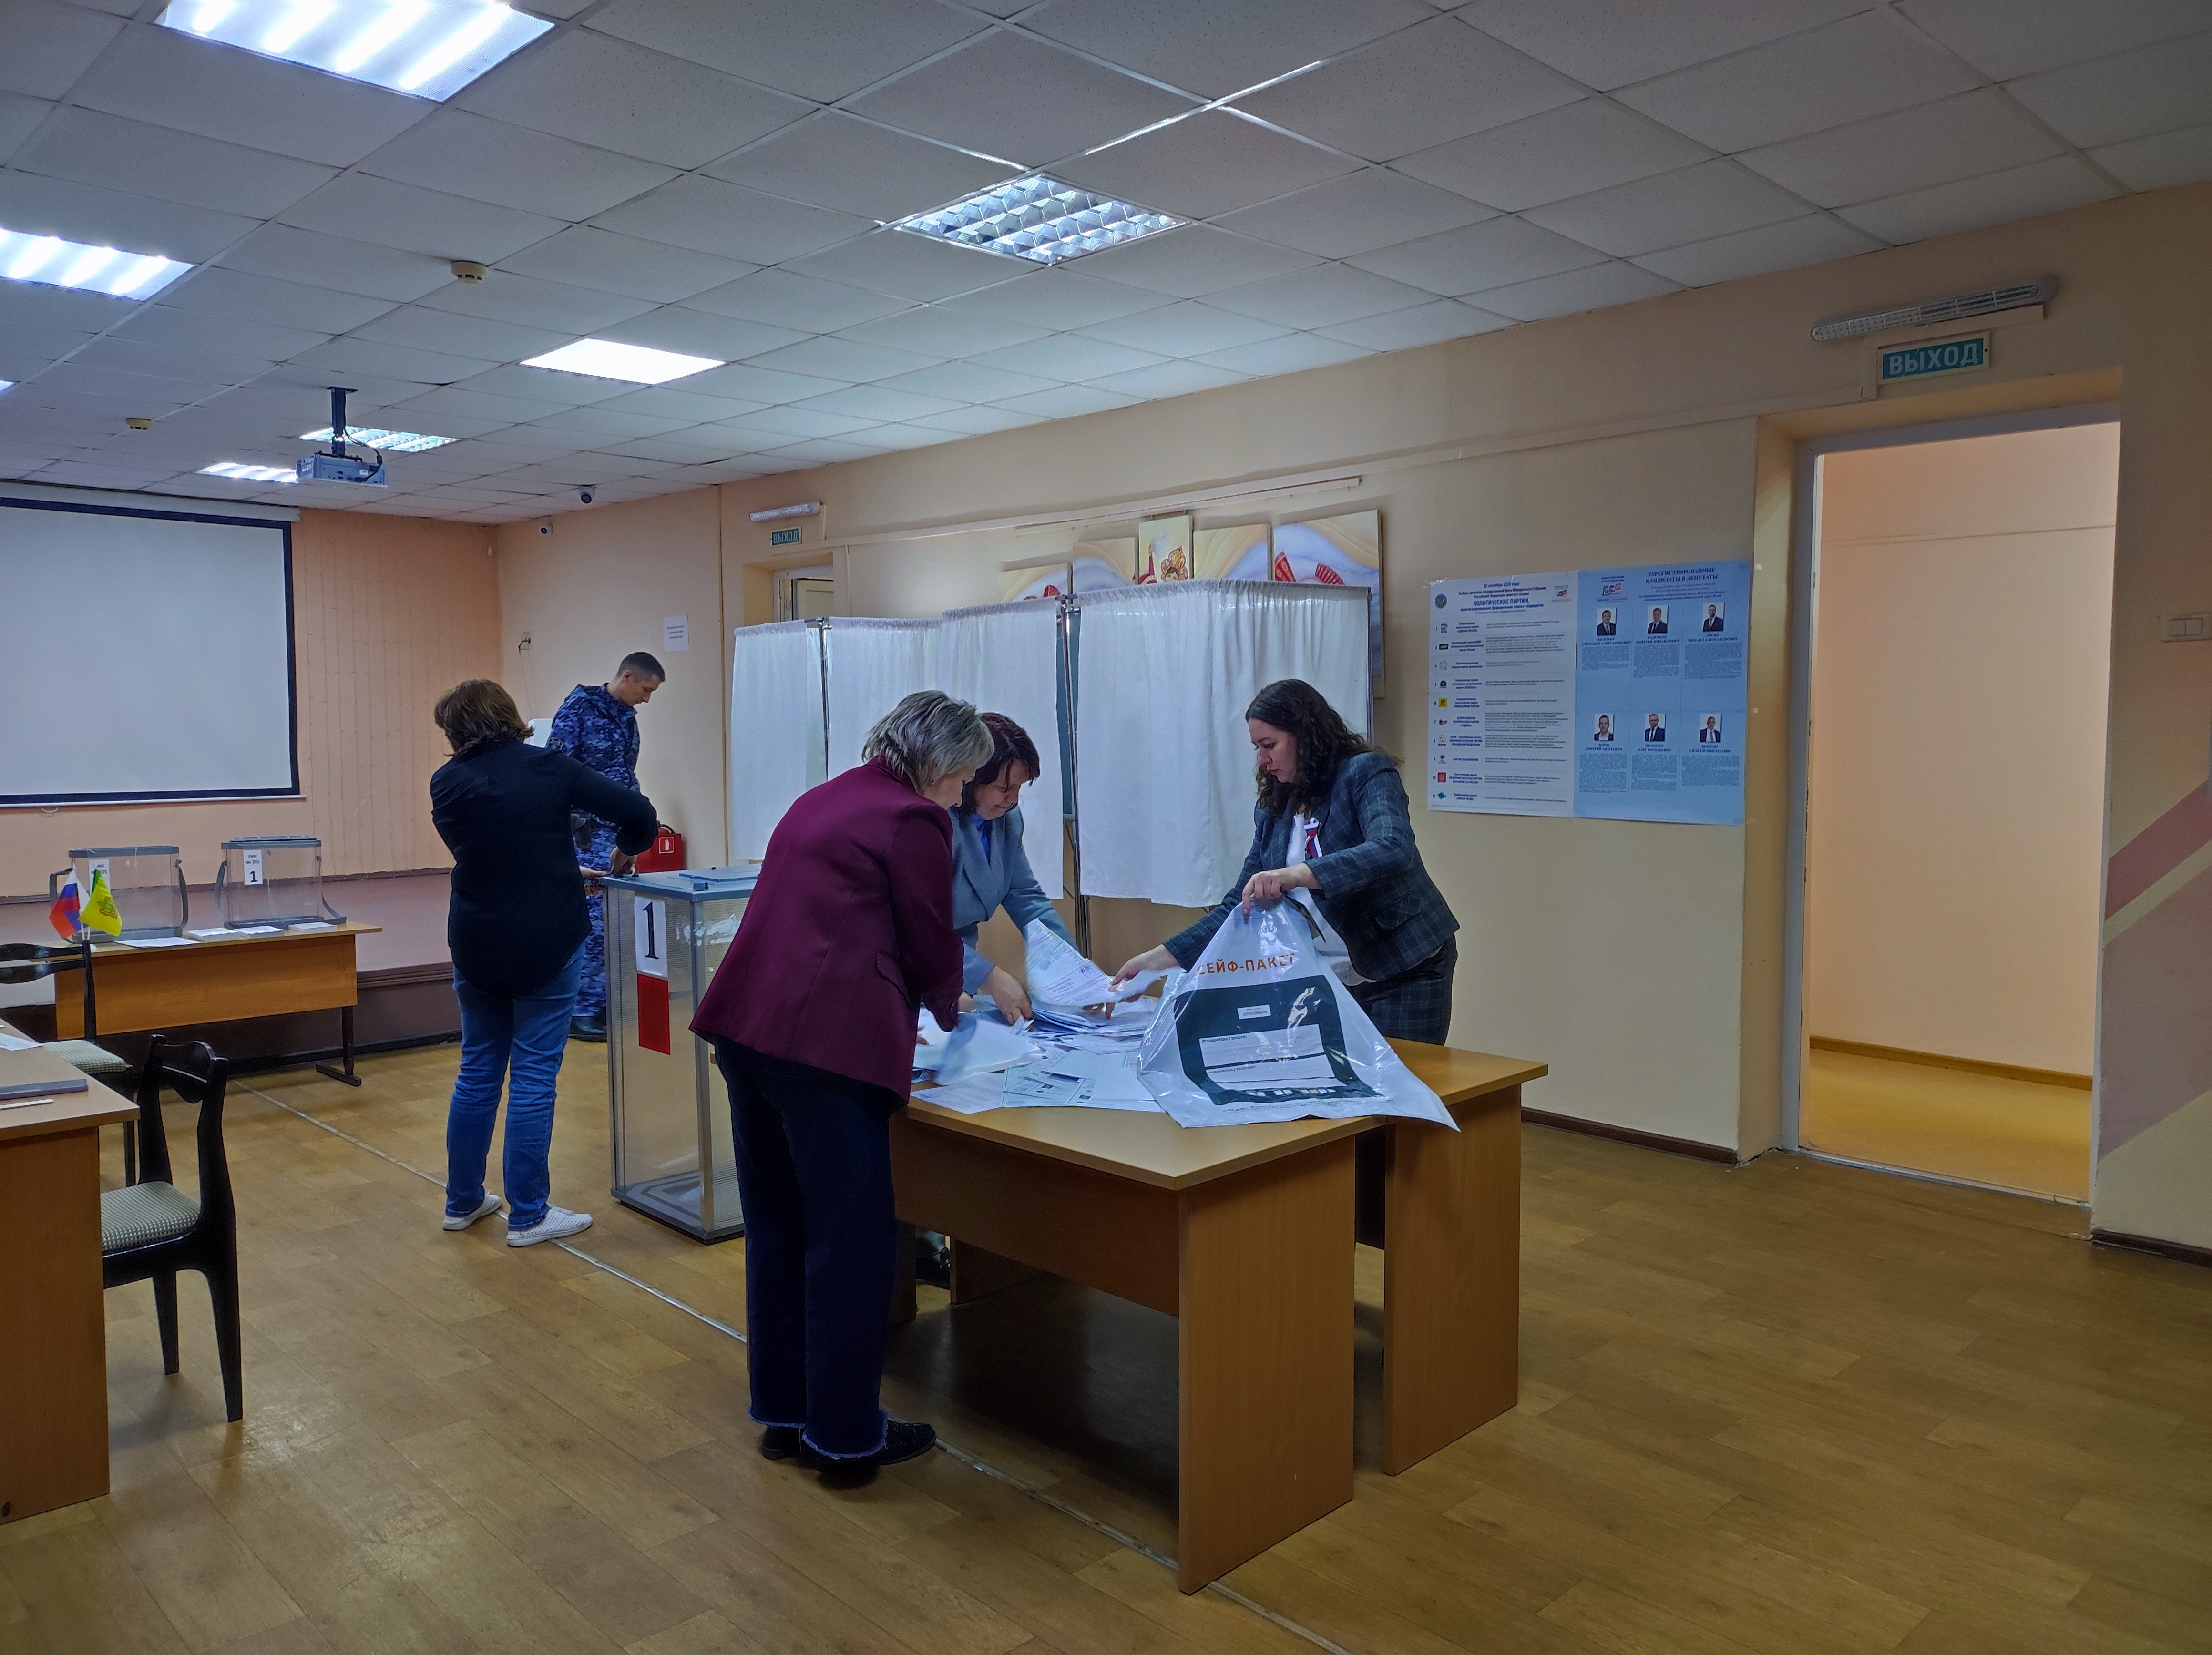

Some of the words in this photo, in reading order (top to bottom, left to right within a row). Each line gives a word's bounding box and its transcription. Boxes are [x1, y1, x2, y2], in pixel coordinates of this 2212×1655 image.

[1889, 343, 1978, 375] ВЫХОД
[774, 530, 799, 544] ВЫХОД
[249, 870, 258, 882] 1
[643, 901, 659, 960] 1
[1197, 953, 1295, 975] СЕЙФ-ПАКЕТ
